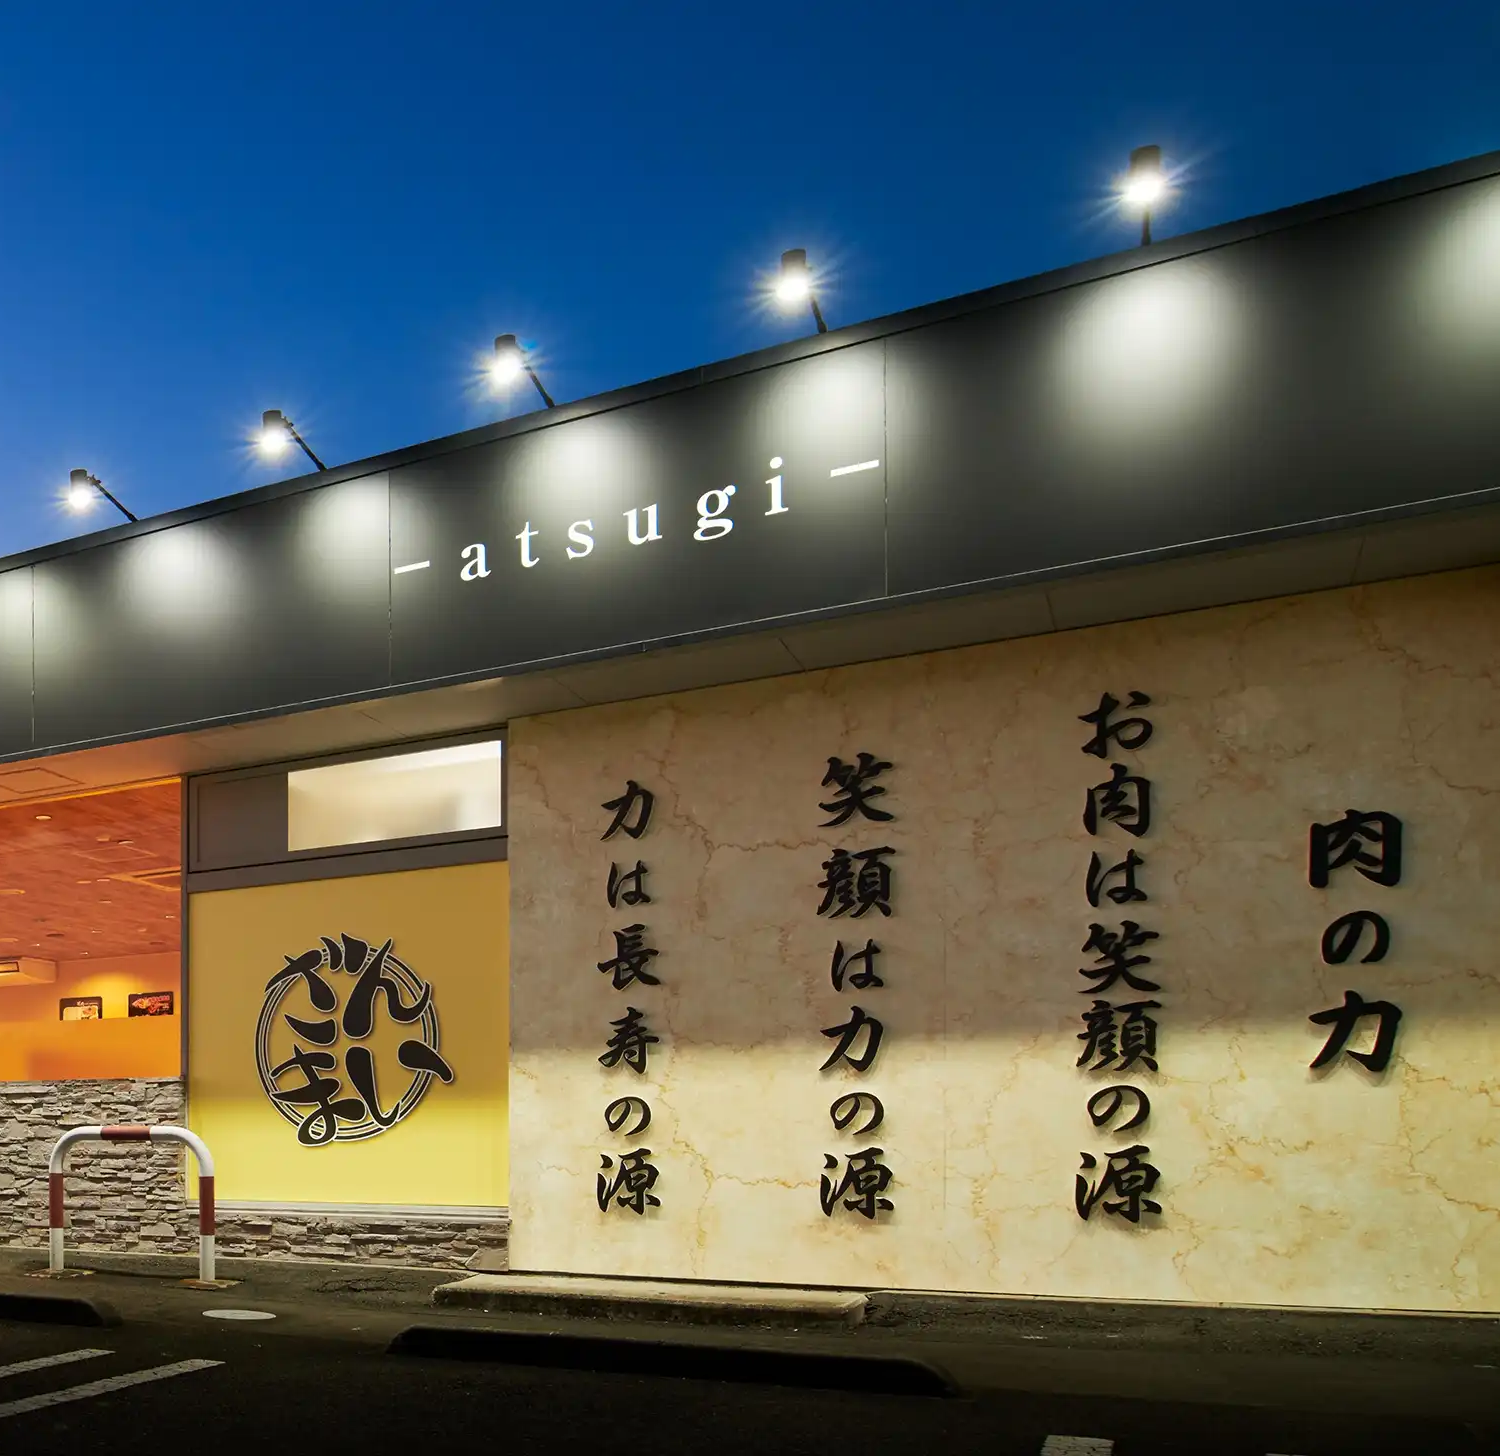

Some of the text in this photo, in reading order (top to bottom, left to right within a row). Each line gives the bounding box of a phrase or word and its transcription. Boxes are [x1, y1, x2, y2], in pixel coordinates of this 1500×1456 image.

[596, 780, 662, 1216] 力は長寿の源
[816, 752, 897, 1220] 笑顔は力の源
[1075, 690, 1163, 1225] お肉は笑顔の源
[1308, 808, 1404, 1074] 肉の力
